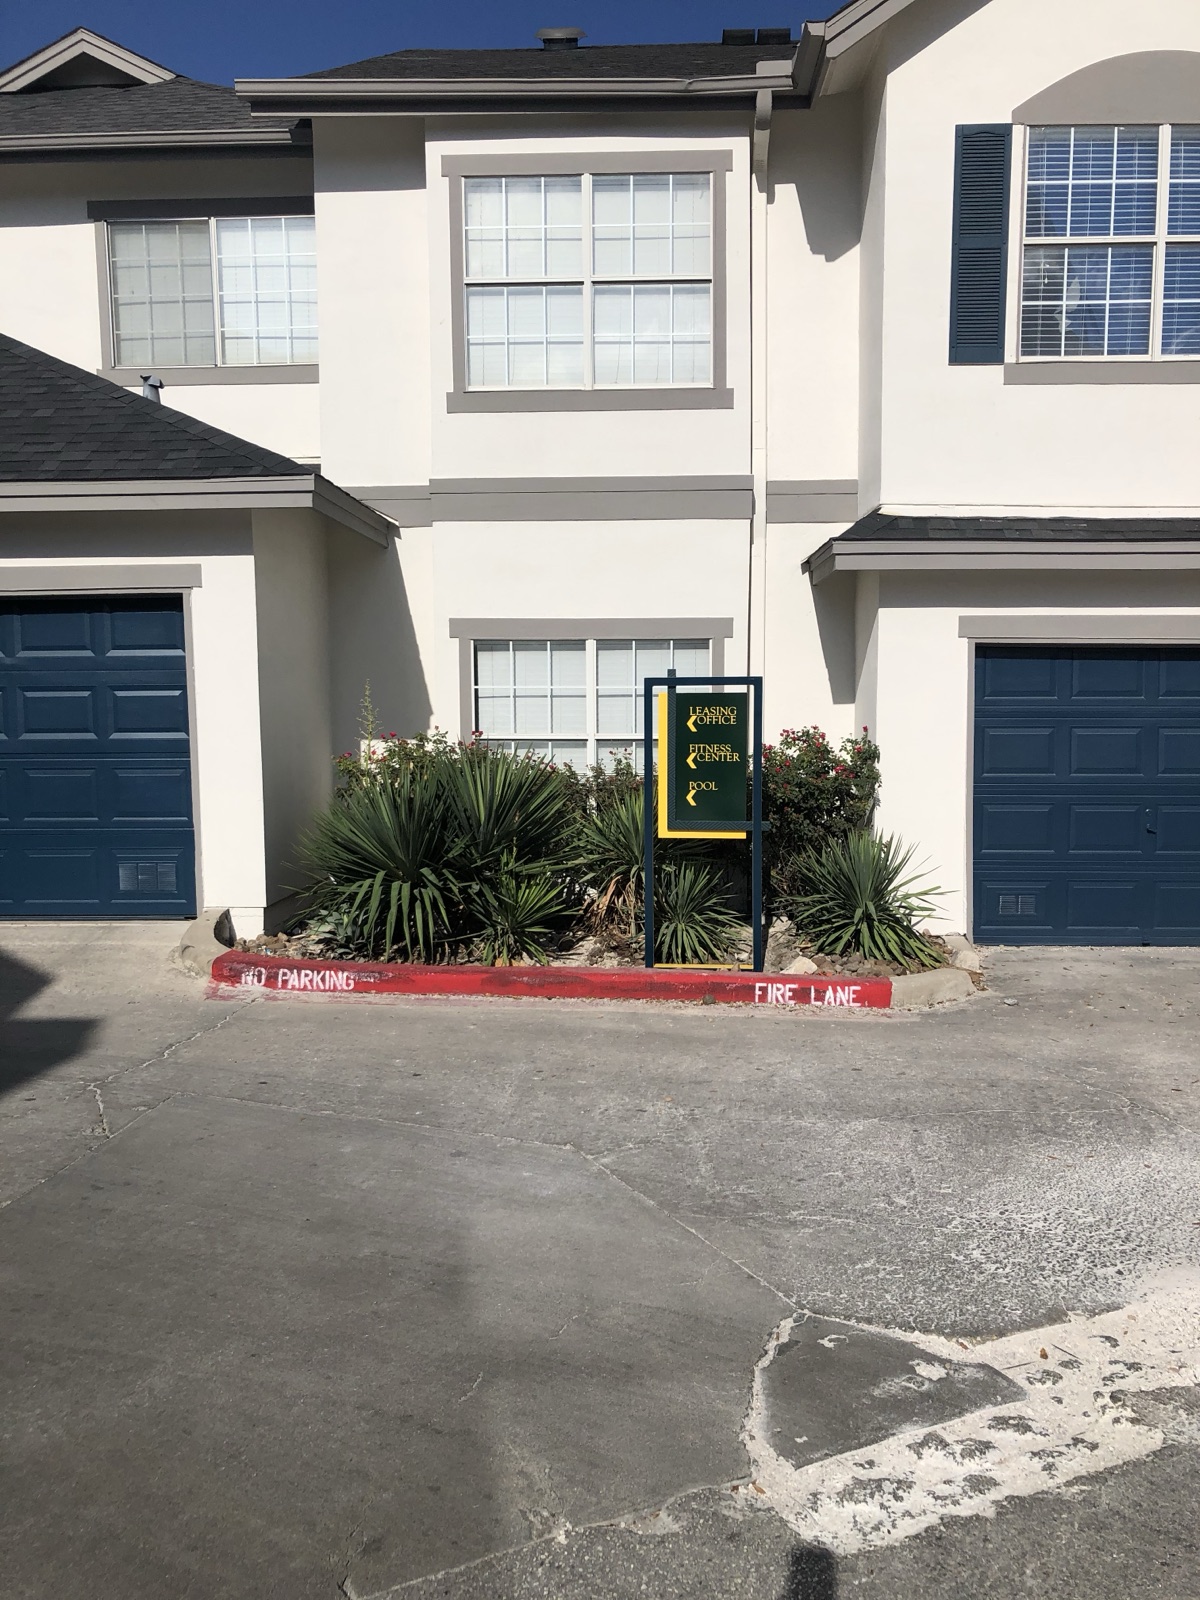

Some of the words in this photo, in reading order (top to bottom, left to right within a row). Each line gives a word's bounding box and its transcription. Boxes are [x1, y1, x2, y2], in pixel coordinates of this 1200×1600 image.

[689, 706, 737, 716] LEASING
[696, 715, 737, 725] OFFICE
[689, 744, 732, 753] FITNESS
[696, 752, 741, 762] CENTER
[689, 781, 718, 791] POOL
[241, 967, 266, 987] NO
[278, 968, 355, 990] PARKING
[755, 982, 799, 1005] FIRE
[810, 985, 862, 1007] LANE
